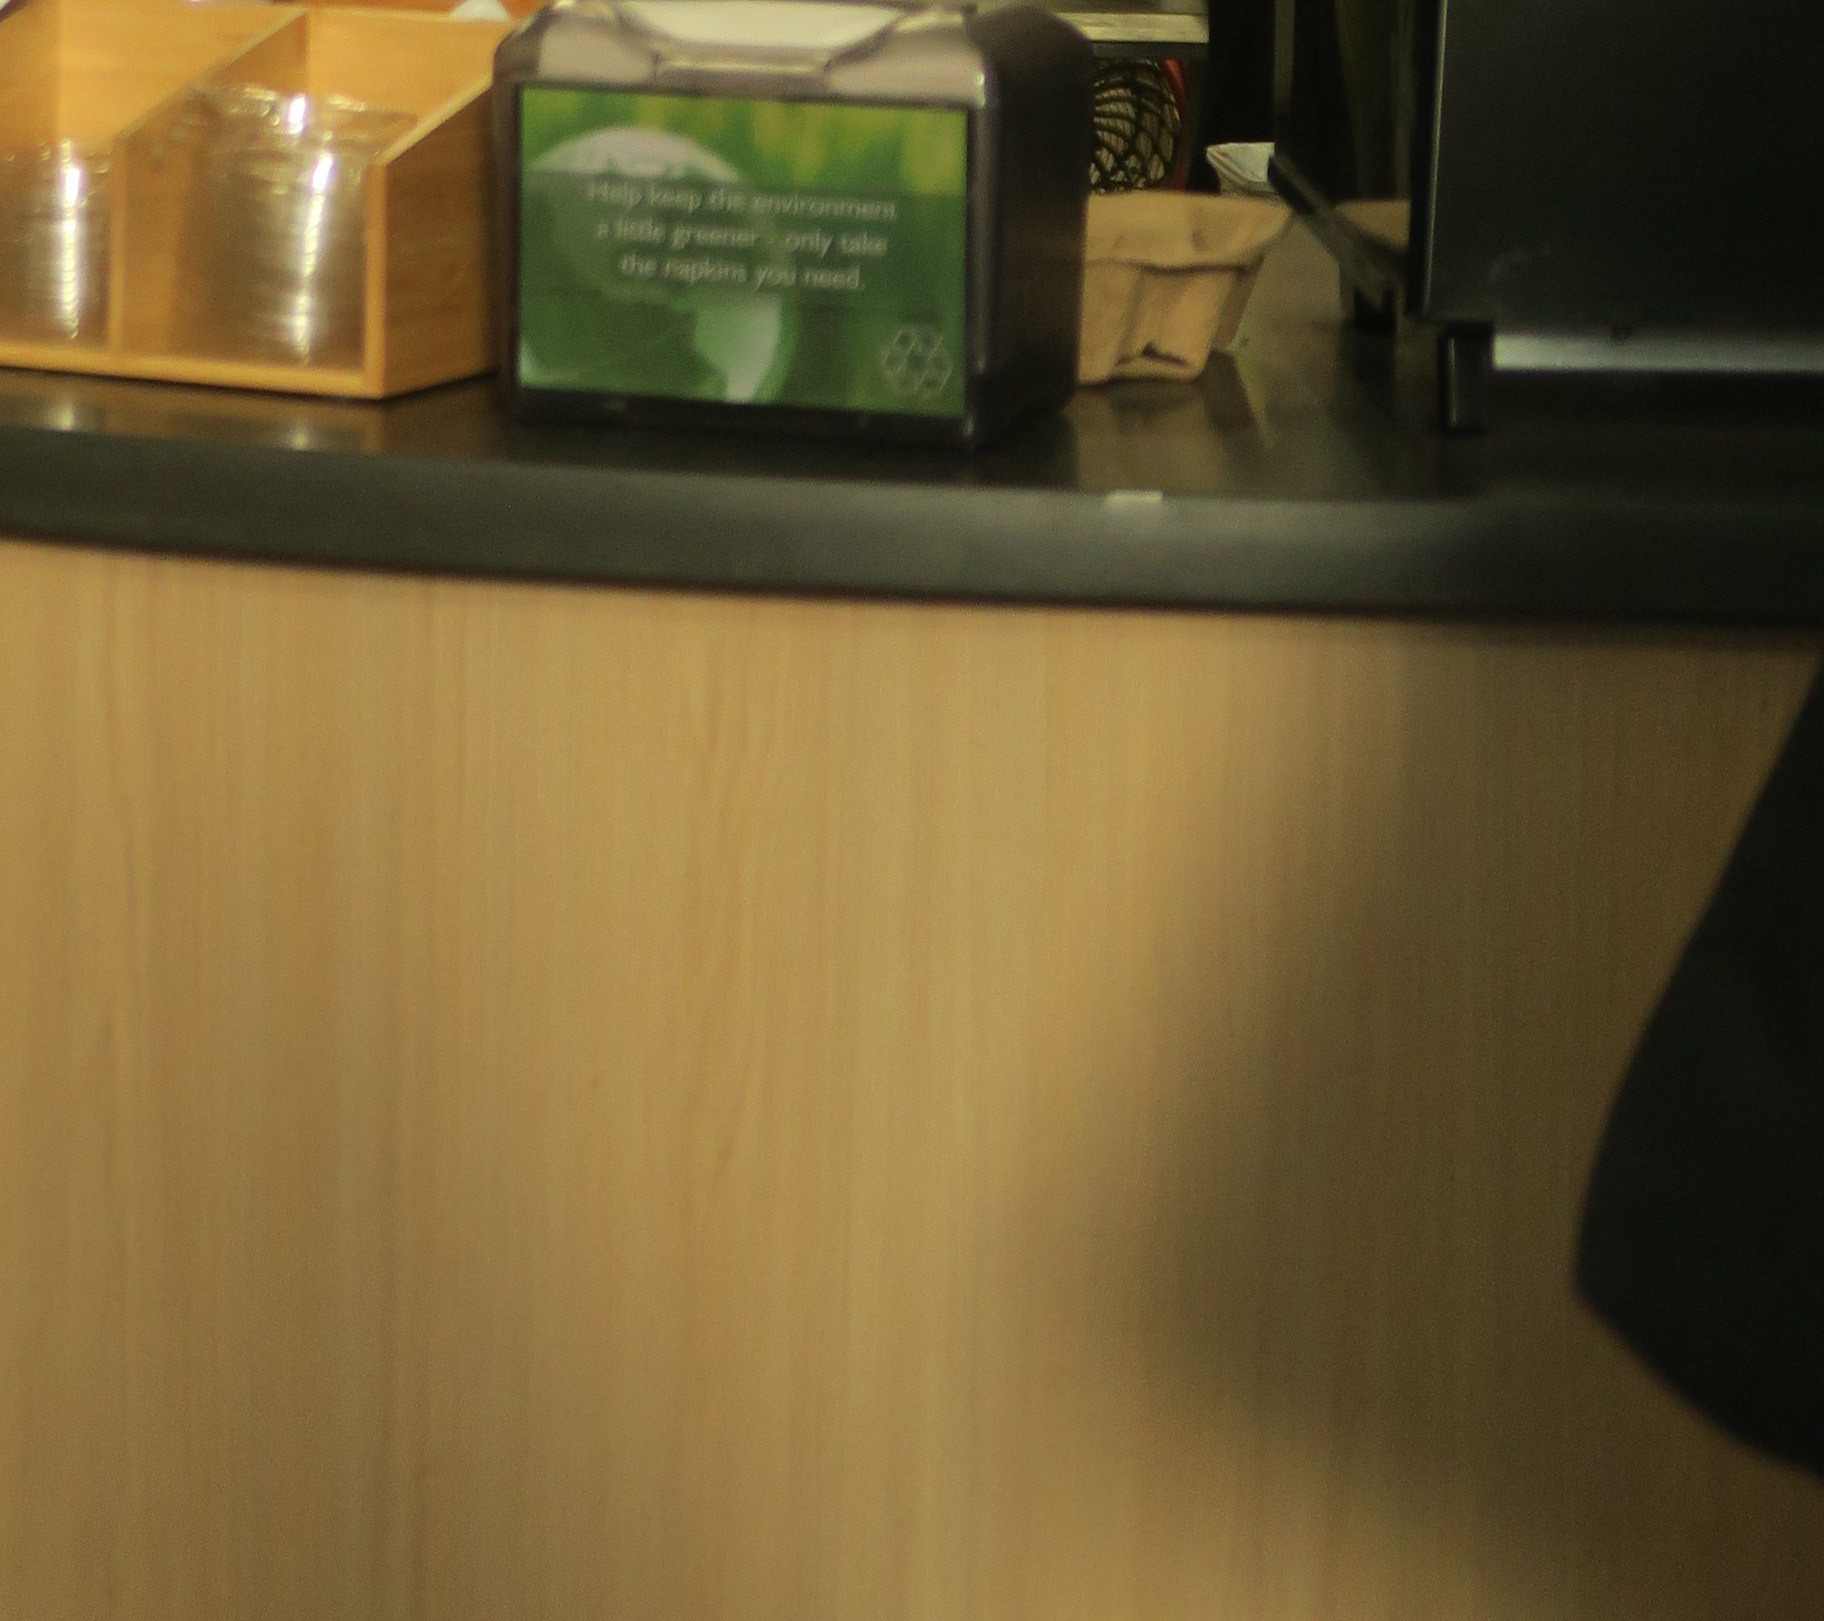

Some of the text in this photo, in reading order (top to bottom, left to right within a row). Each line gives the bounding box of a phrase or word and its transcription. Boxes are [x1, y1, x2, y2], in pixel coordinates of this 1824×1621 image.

[587, 181, 897, 221] Help keep the environment
[784, 228, 833, 258] only
[839, 232, 888, 256] take
[620, 253, 658, 277] the
[753, 264, 797, 291] you
